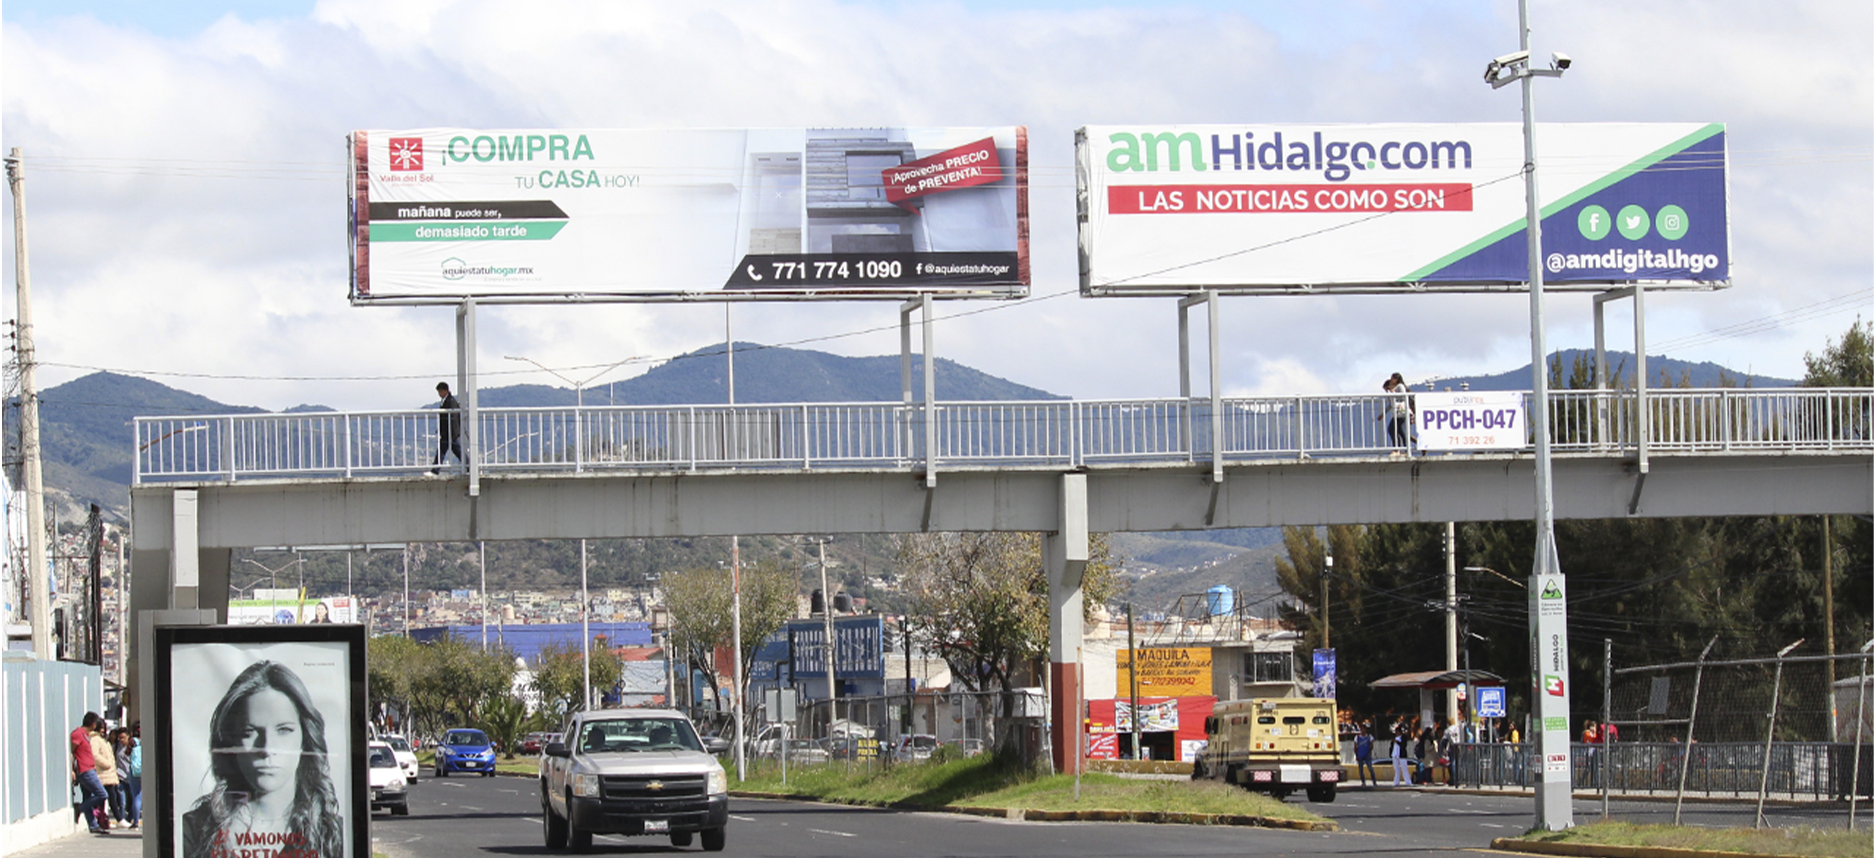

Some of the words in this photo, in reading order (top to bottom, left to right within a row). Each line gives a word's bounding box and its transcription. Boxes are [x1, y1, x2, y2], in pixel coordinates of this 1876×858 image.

[442, 134, 595, 166] ¡COMPRA
[890, 162, 945, 185] ¡Aprovecha
[945, 149, 989, 169] PRECIO
[380, 174, 401, 182] Valle
[403, 174, 417, 182] del
[419, 173, 434, 182] Sol
[515, 176, 534, 189] TU
[538, 170, 601, 189] CASA
[604, 175, 640, 188] HOY!
[904, 184, 918, 194] de
[918, 166, 982, 191] PREVENTA!
[1138, 190, 1184, 211] LAS
[1197, 189, 1309, 211] NOTICIAS
[1314, 188, 1388, 209] COMO
[1394, 188, 1445, 209] SON
[398, 205, 451, 218] mañana
[455, 208, 482, 219] puede
[483, 209, 502, 219] ser,
[415, 225, 489, 238] demasiado
[492, 225, 527, 237] tarde
[772, 262, 806, 280] 771
[813, 261, 850, 279] 774
[855, 260, 902, 279] 1090
[924, 263, 1010, 275] @aquiestatuhogar
[1546, 248, 1719, 274] @amdigitalhgo
[442, 265, 534, 277] aquiestatuhogar.mx
[1423, 409, 1517, 430] PPCH-047
[1449, 436, 1459, 445] 71
[1463, 436, 1480, 445] 392
[1483, 435, 1495, 445] 26
[1137, 649, 1190, 661] MAQUILA
